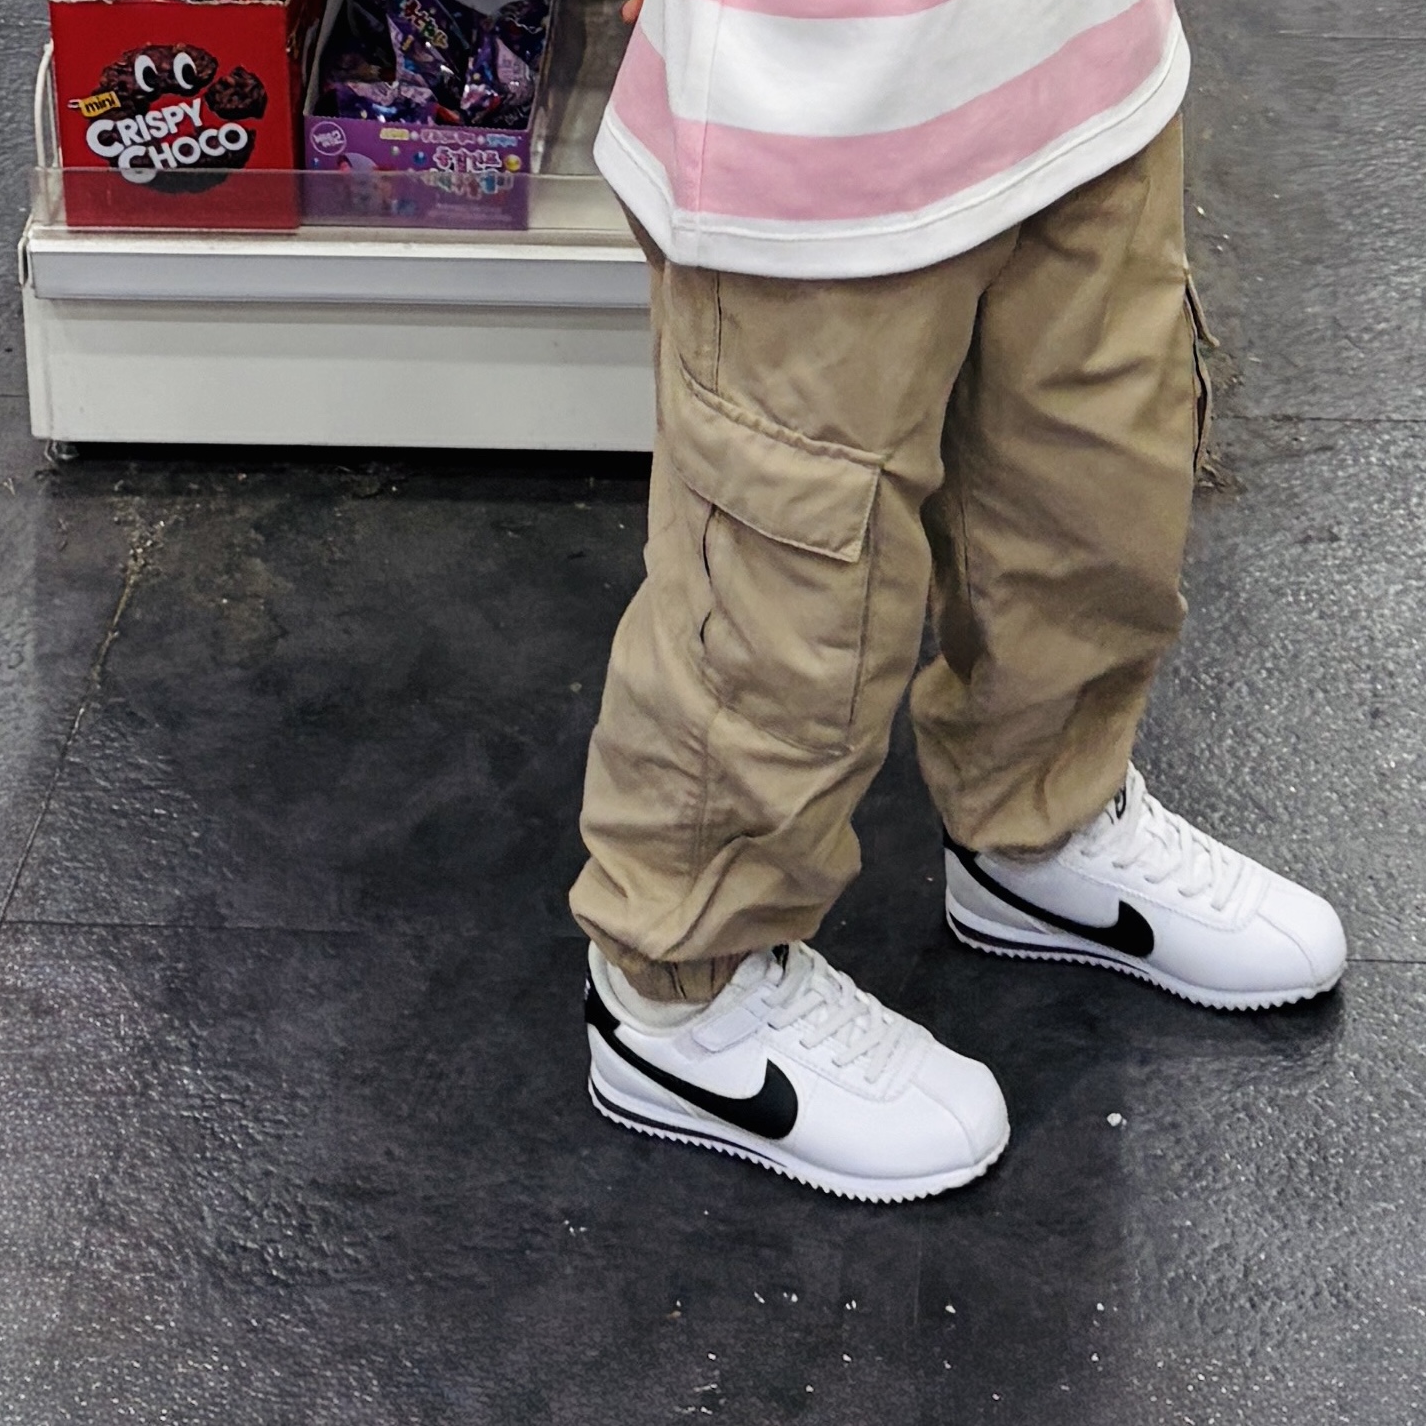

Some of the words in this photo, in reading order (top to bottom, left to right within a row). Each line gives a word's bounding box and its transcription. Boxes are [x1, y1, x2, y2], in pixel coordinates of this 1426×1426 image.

[81, 93, 119, 116] mini
[87, 99, 203, 156] CRISPY
[118, 121, 249, 182] CHOCO
